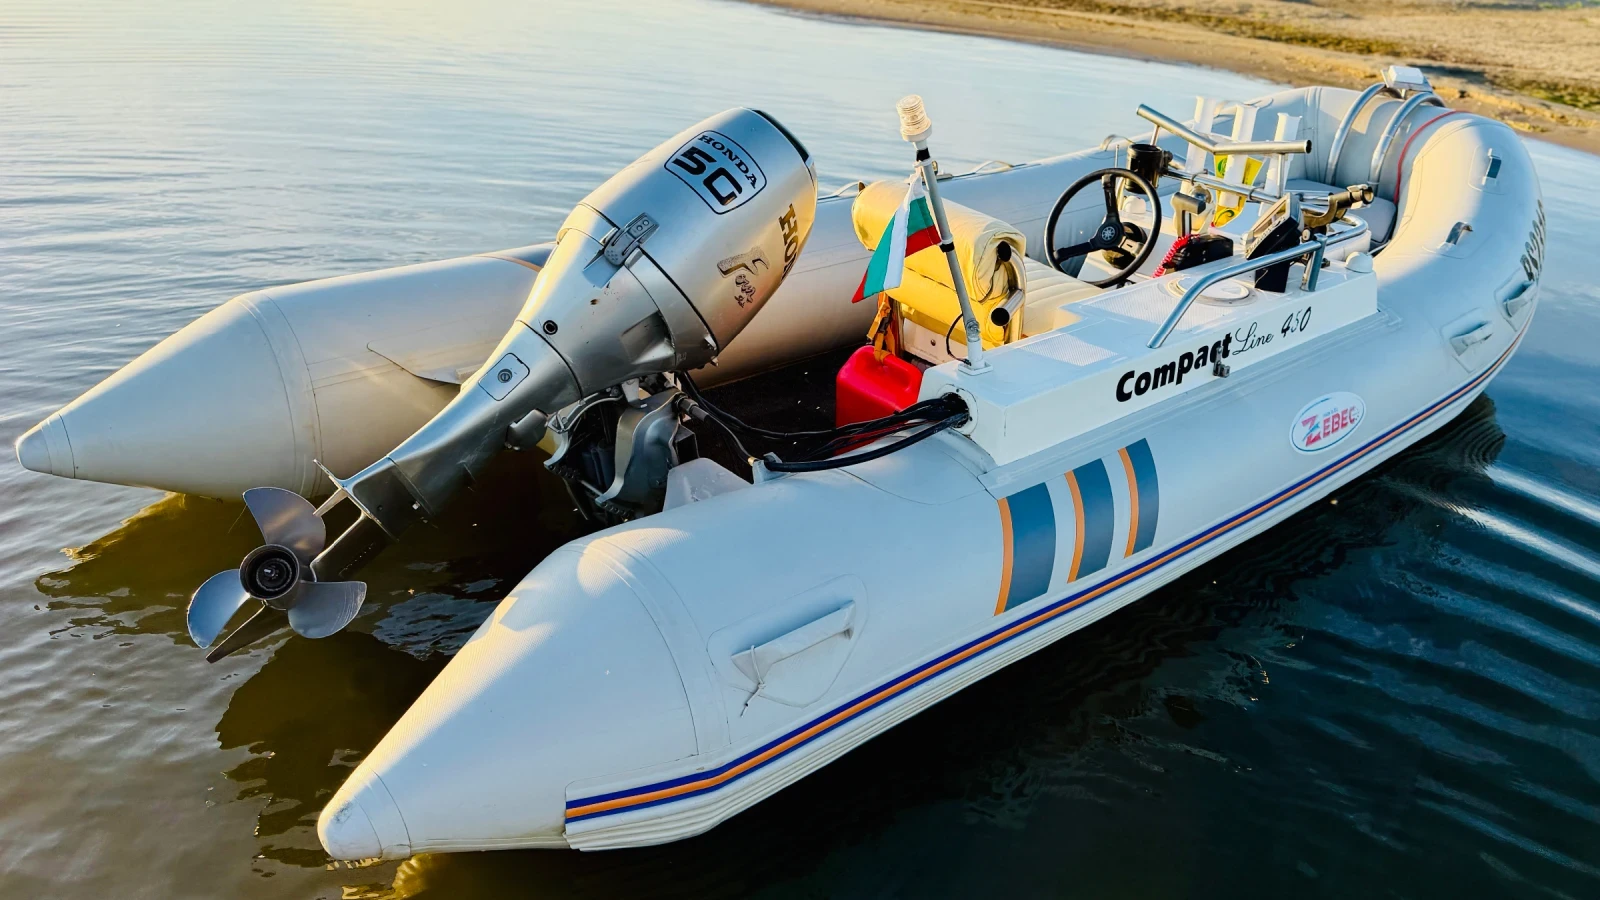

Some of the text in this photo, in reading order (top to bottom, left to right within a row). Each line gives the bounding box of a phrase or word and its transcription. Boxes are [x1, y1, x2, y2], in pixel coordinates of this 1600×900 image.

[672, 146, 743, 206] 50
[698, 134, 758, 190] HONDA
[1115, 306, 1312, 402] Compact Line 450
[1301, 406, 1356, 447] ZEBEC
